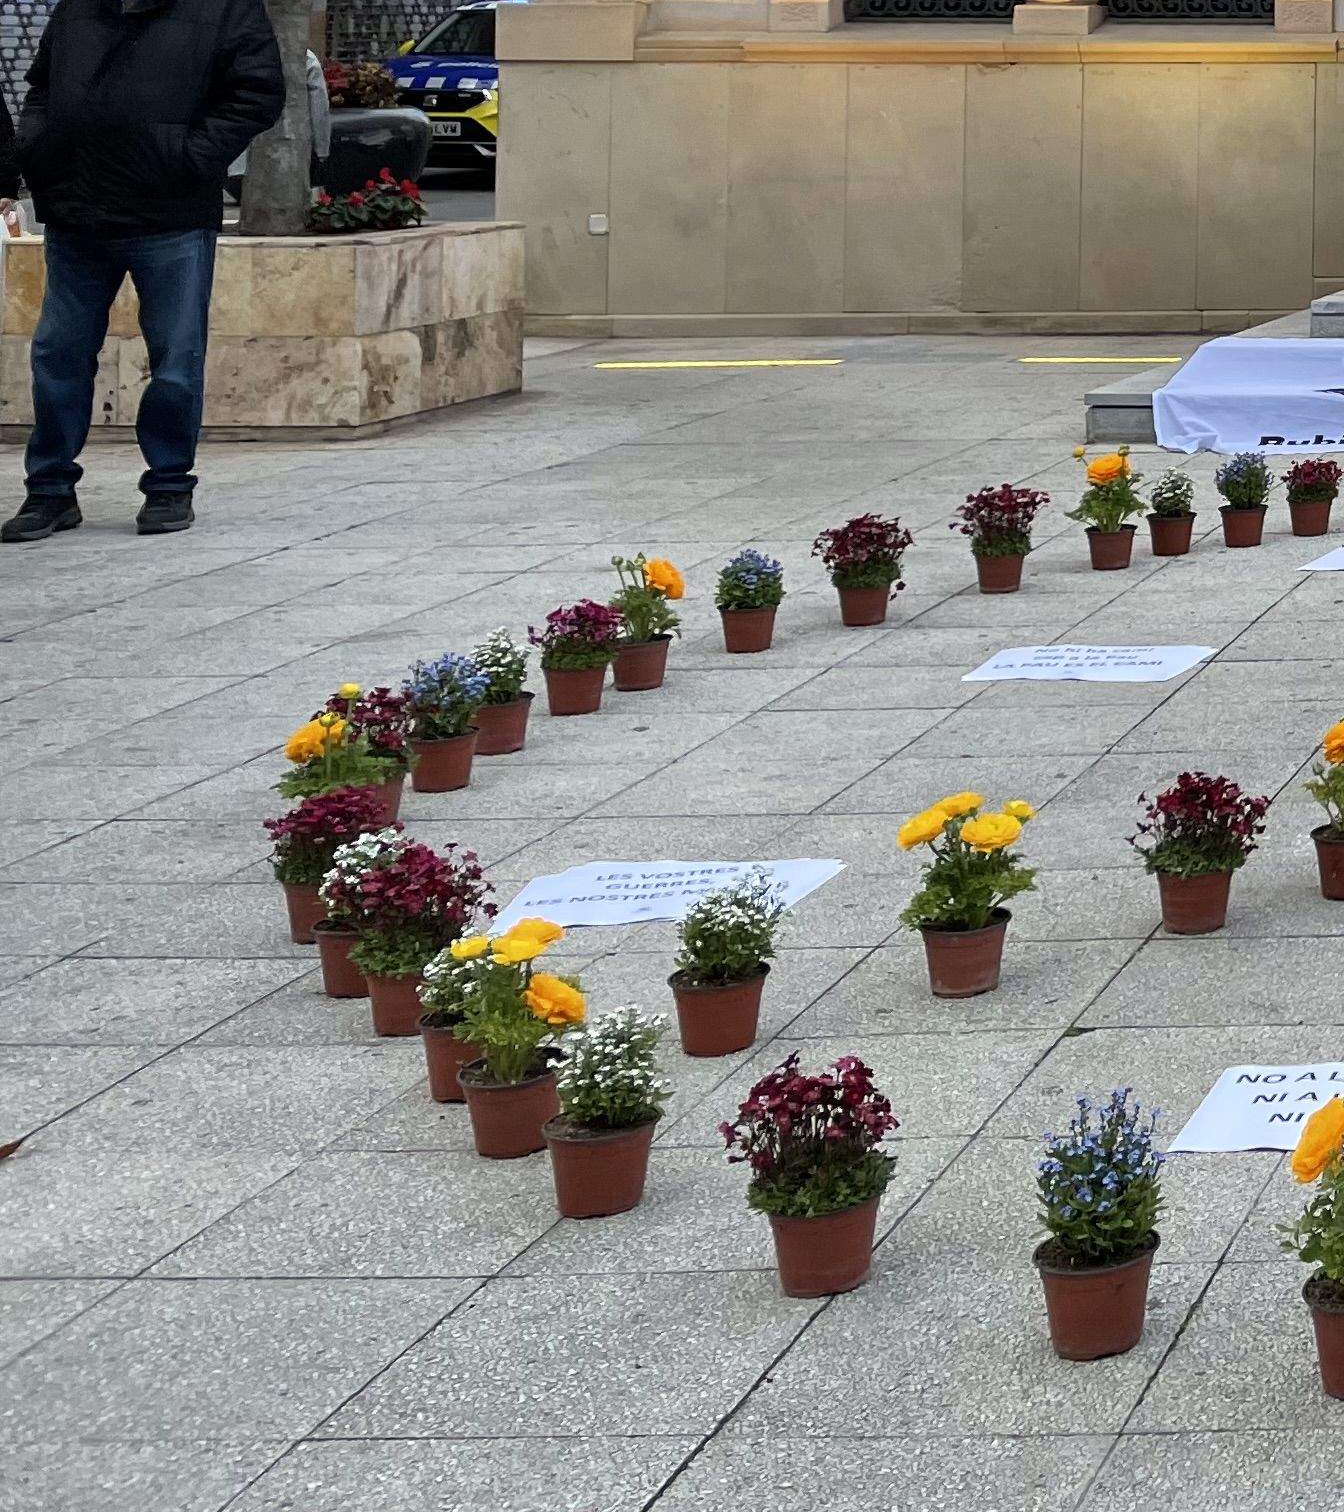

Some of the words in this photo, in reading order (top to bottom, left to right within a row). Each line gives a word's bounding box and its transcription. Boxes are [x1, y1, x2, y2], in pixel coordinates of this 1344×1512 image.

[596, 872, 635, 882] LES
[639, 866, 740, 880] VOSTRES
[524, 896, 564, 907] LES
[569, 889, 677, 904] NOSTRES
[1236, 1073, 1288, 1085] NO
[1292, 1071, 1318, 1083] A
[1252, 1092, 1286, 1104] NI
[1293, 1091, 1320, 1102] A
[1268, 1111, 1306, 1124] NI
